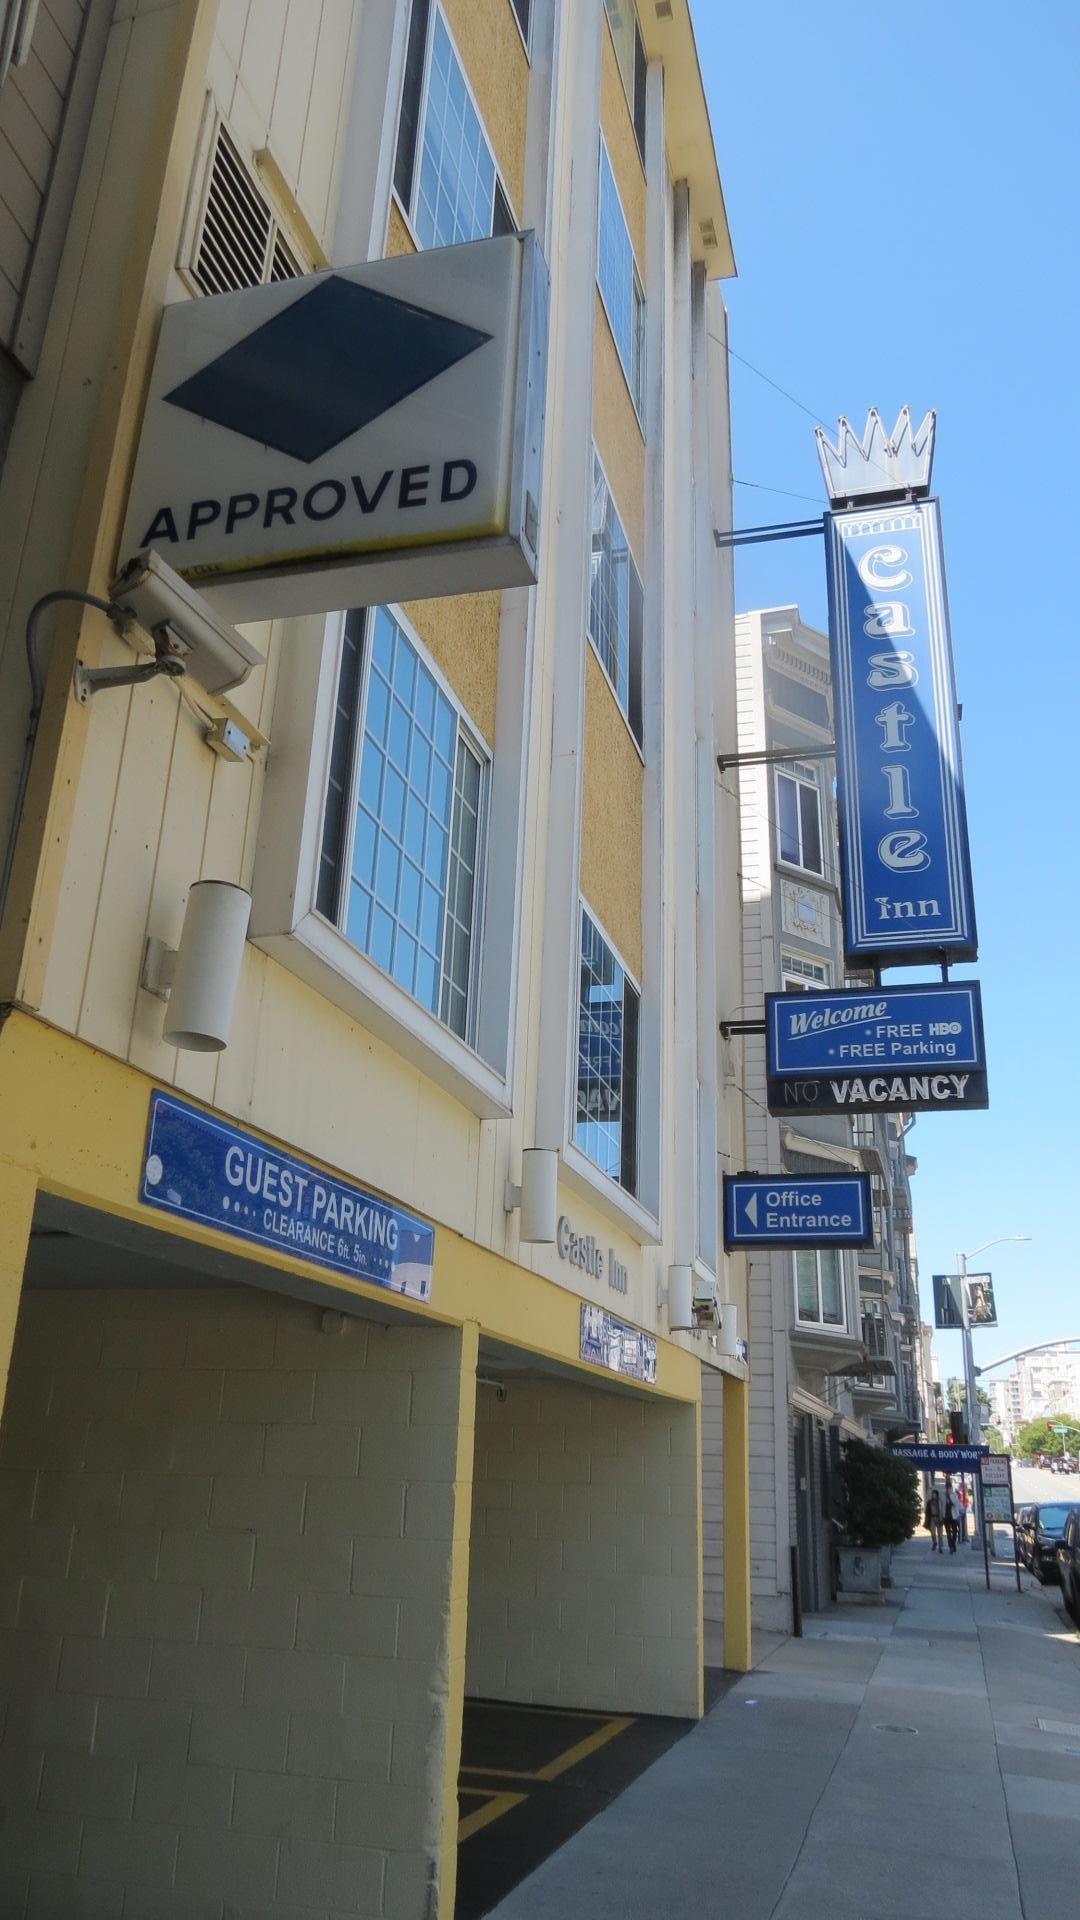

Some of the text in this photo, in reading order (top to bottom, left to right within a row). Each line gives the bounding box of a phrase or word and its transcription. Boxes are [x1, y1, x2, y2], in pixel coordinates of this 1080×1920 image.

[139, 459, 478, 548] APPROVED
[789, 1001, 887, 1036] Welcome
[876, 1022, 962, 1039] FREE HBO
[839, 1041, 957, 1058] FREE Parking
[829, 1074, 970, 1104] VACANCY
[225, 1146, 399, 1251] GUEST PARKING
[766, 1191, 822, 1207] Office
[263, 1208, 336, 1254] CLEARANCE
[766, 1212, 852, 1228] Entrance
[557, 1215, 628, 1295] Castle Inn
[930, 1449, 937, 1458] &
[939, 1450, 960, 1459] BODY
[960, 1450, 983, 1460] WOR
